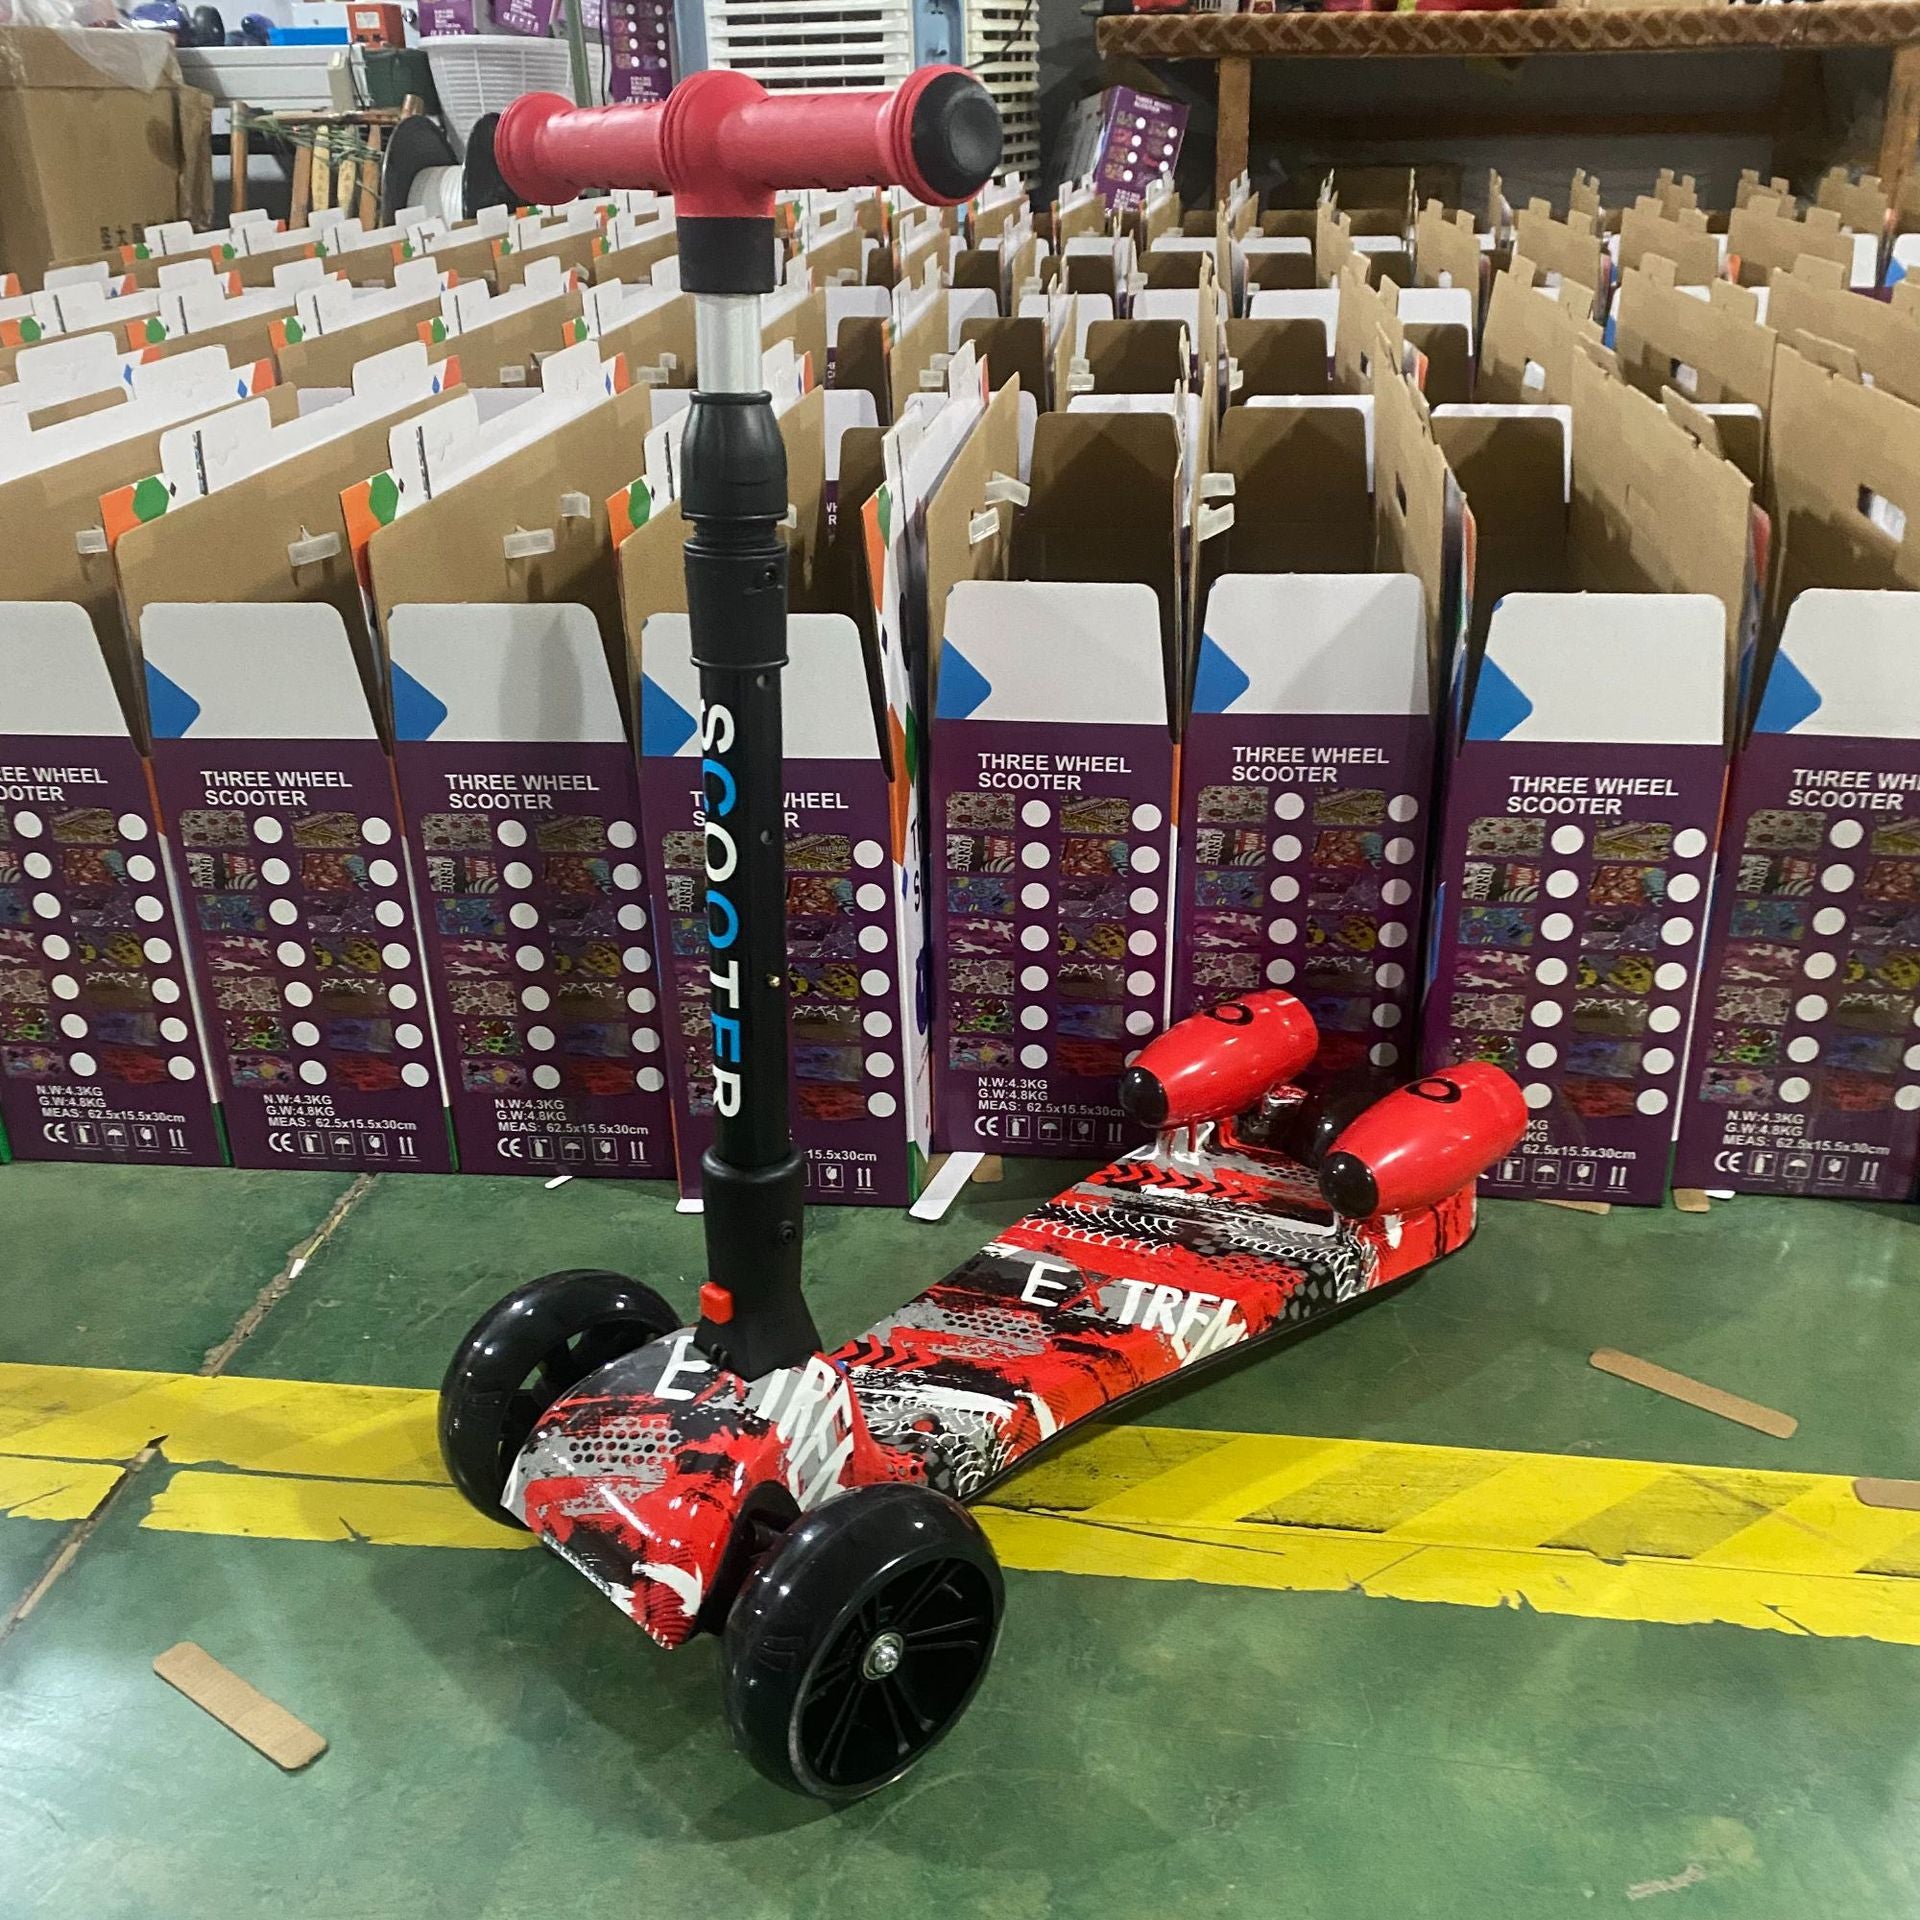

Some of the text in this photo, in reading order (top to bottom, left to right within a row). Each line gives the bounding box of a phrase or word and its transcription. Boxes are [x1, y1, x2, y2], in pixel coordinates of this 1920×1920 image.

[978, 753, 1131, 773] THREE WHEEL
[1232, 746, 1390, 764] THREE WHEEL
[33, 767, 108, 784] WHEEL
[200, 771, 352, 788] THREE WHEEL
[978, 772, 1081, 791] SCOOTER
[1231, 766, 1338, 782] SCOOTER
[1792, 768, 1873, 789] THREE
[444, 774, 600, 791] THREE WHEEL
[1509, 776, 1679, 796] THREE WHEEL
[205, 790, 307, 806] SCOOTER
[449, 793, 554, 810] SCOOTER
[784, 792, 849, 809] HEEL
[1506, 796, 1622, 815] SCOOTER
[1787, 789, 1905, 811] SCOOTER
[701, 698, 740, 1118] SCOOTER
[978, 1077, 1048, 1089] N.W:4.3KG
[263, 1094, 332, 1105] N.W:4.3KG
[978, 1089, 1048, 1101] G.W:4.8KG
[42, 1107, 83, 1118] MEAS:
[266, 1106, 335, 1117] G.W:4.8KG
[494, 1099, 565, 1110] N.W:4.3KG
[978, 1100, 1021, 1111] MEAS:
[268, 1117, 417, 1130] MEAS: 62.5x15.5x30cm
[496, 1110, 567, 1121] G.W:4.8KG
[498, 1122, 649, 1135] MEAS: 62.5x15.5x30cm
[1722, 1134, 1771, 1147] MEAS:
[806, 1149, 877, 1161] 15.5x30cm
[1522, 1144, 1637, 1160] 62.5x15.5x30cm
